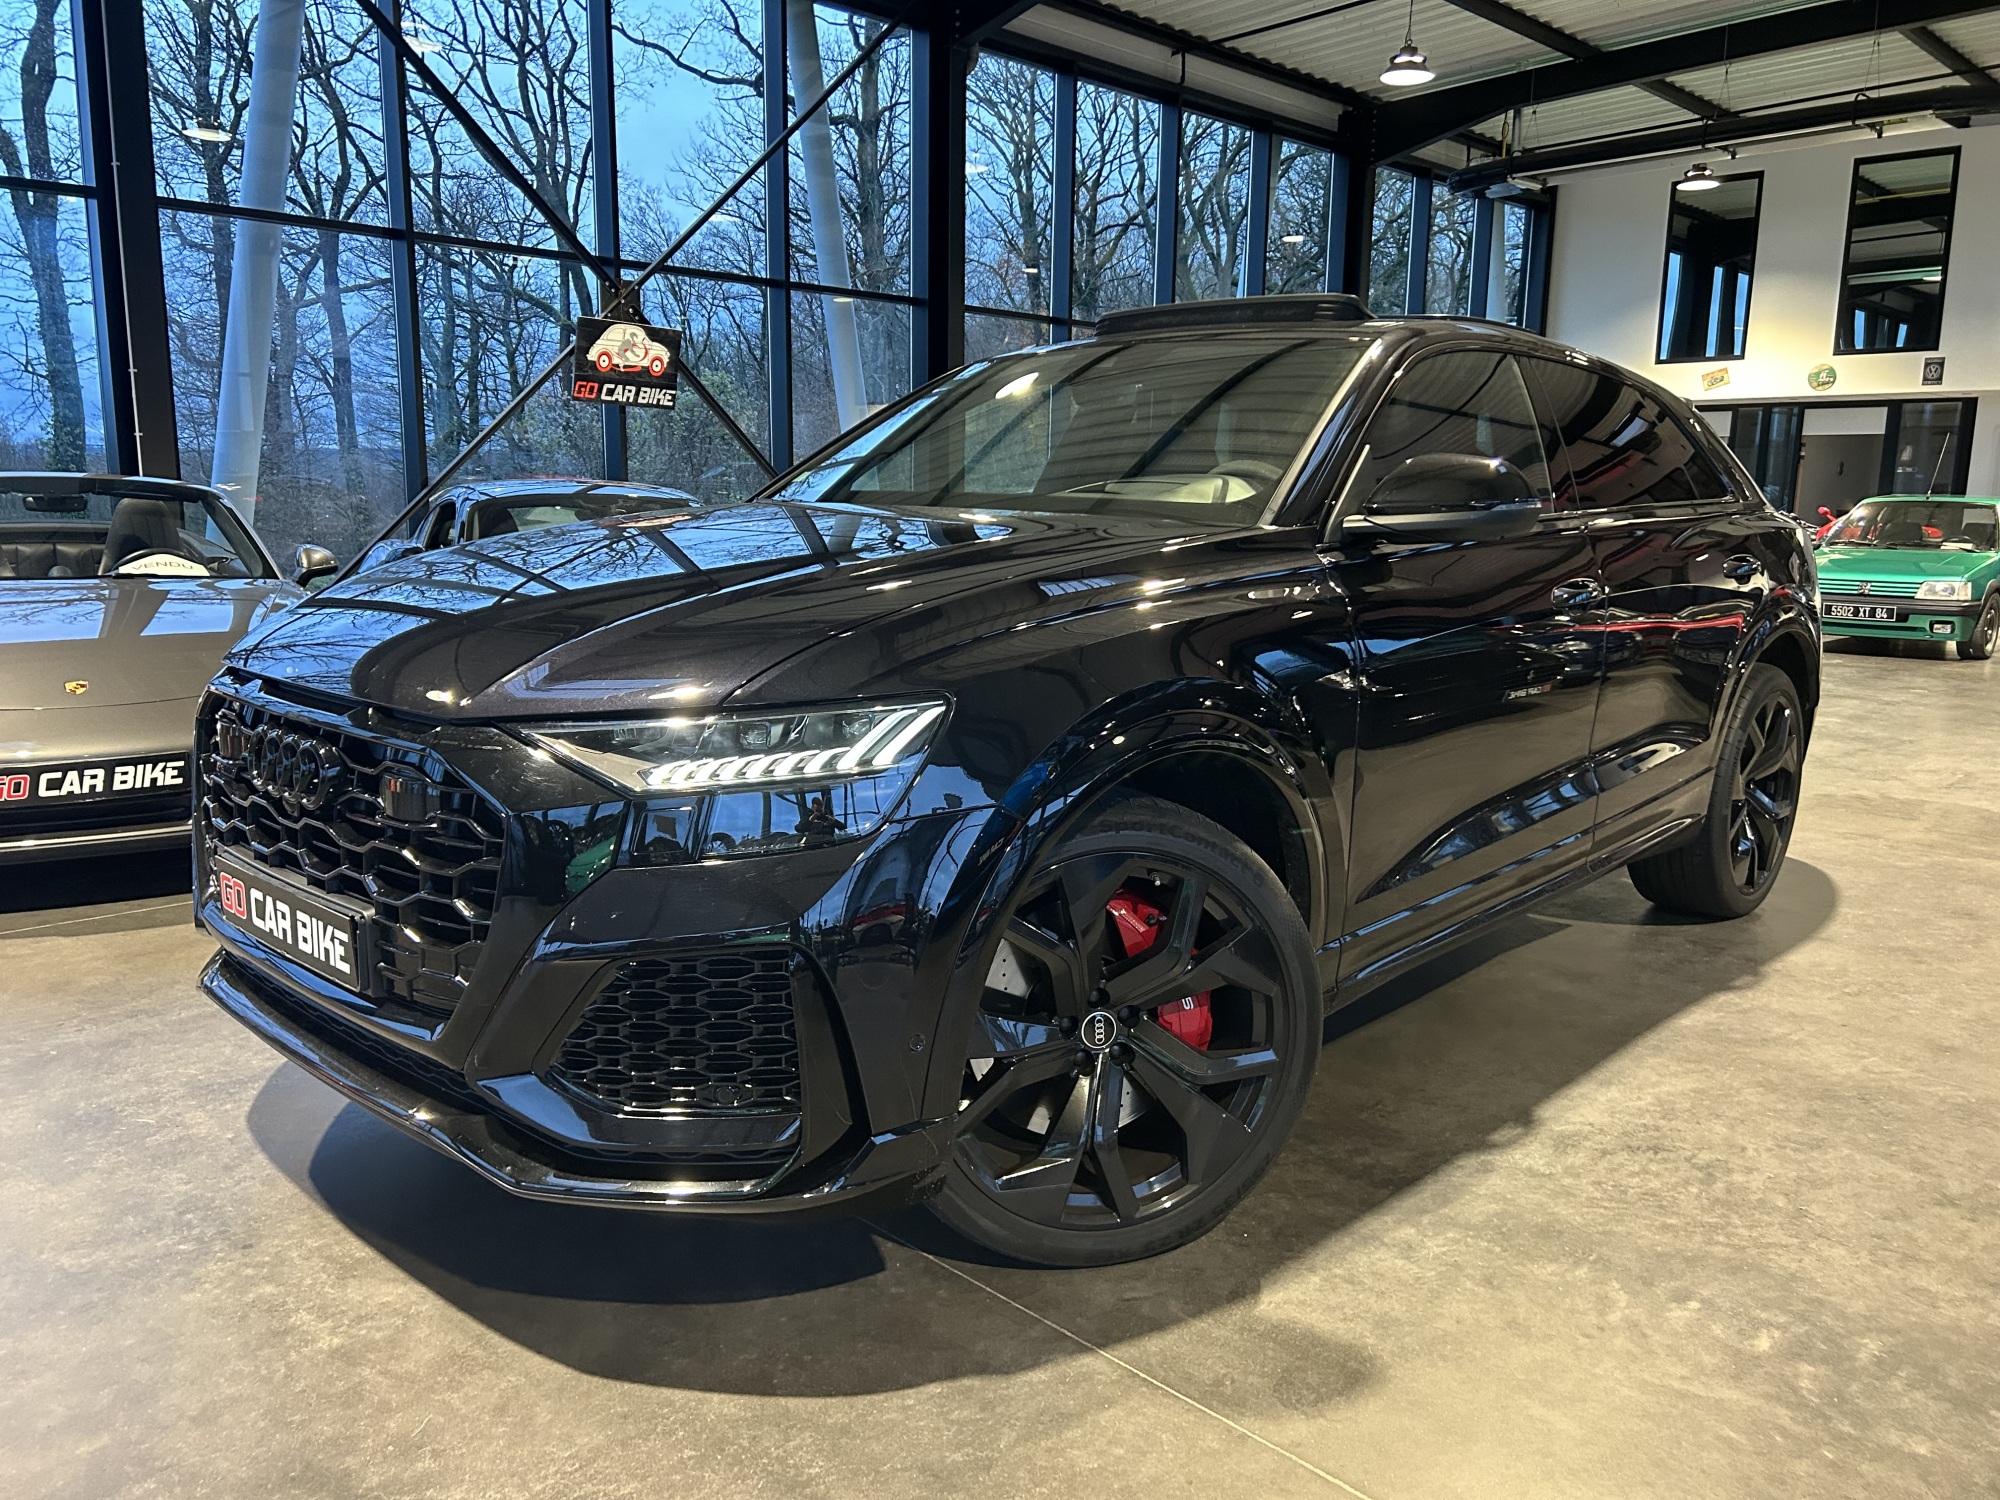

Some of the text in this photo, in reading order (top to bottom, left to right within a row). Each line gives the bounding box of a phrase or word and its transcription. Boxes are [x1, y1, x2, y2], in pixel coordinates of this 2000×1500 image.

[573, 381, 676, 406] GO CAR BIKE
[131, 561, 194, 571] VENDU
[1830, 605, 1888, 619] 5502 XT 84
[38, 769, 105, 797] CAR
[112, 760, 185, 791] BIKE
[220, 871, 351, 975] GO CAR BIKE
